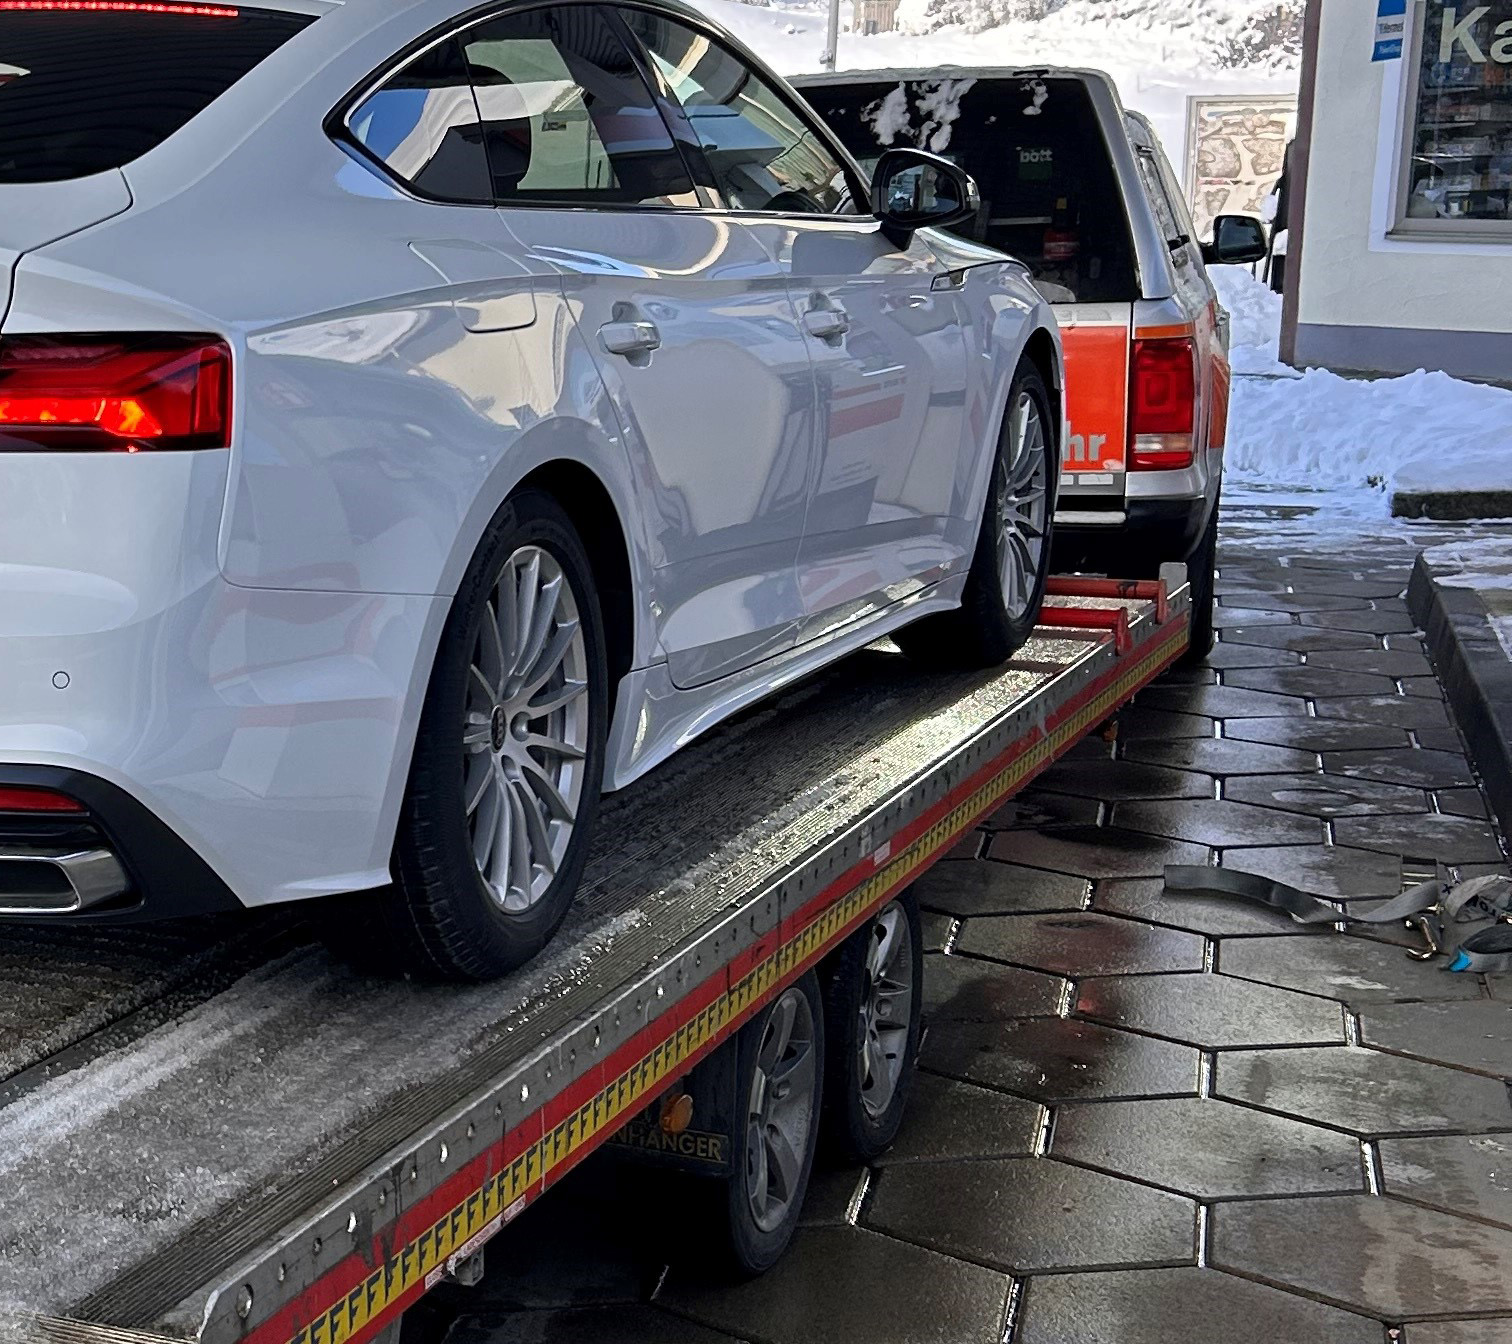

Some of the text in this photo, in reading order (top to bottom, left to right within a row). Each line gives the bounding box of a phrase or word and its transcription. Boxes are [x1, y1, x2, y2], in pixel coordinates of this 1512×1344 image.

[1439, 6, 1512, 64] Ka
[1019, 149, 1053, 163] bott
[1062, 420, 1107, 462] hr
